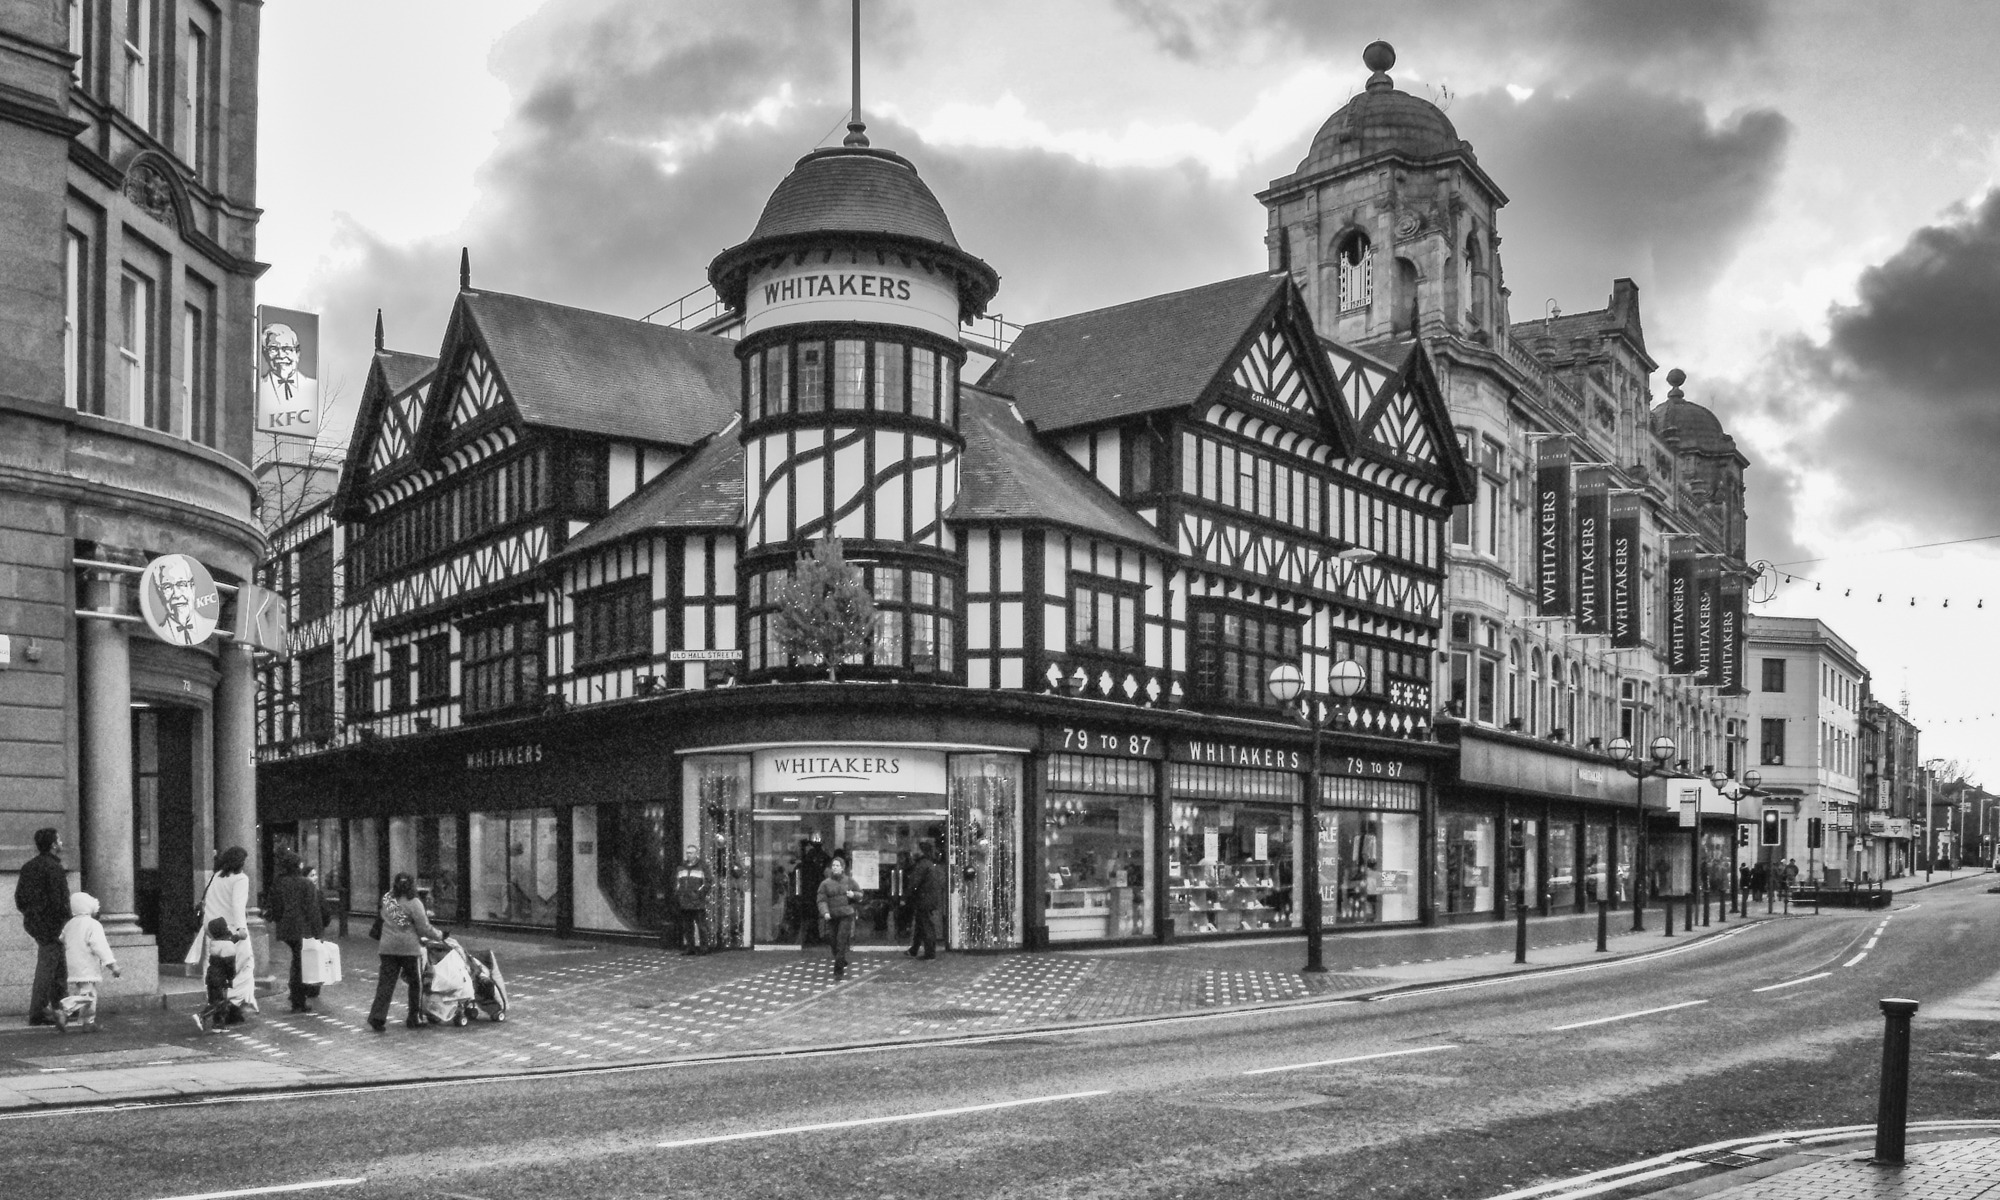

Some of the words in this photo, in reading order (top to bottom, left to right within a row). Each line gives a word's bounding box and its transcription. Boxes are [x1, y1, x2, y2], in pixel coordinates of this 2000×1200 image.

[763, 273, 912, 306] WHITAKERS
[269, 409, 311, 428] KFC
[1542, 490, 1556, 605] WHITAKERS
[1582, 517, 1595, 624] WHITAKERS
[196, 592, 218, 608] KFC
[1615, 537, 1628, 638] WHITAKERS
[1673, 577, 1685, 666] WHITAKERS
[1722, 610, 1734, 689] WHITAKERS
[1063, 728, 1088, 750] 79
[1100, 734, 1118, 749] TO
[1129, 735, 1151, 755] 87
[1189, 741, 1299, 769] WHITAKERS
[466, 743, 542, 769] WHITAKERS
[774, 757, 900, 774] WHITAKERS
[1347, 757, 1363, 774] 79
[1370, 762, 1382, 774] TO
[1388, 761, 1403, 778] 87
[1319, 826, 1337, 843] ALE
[1319, 885, 1335, 902] ALE
